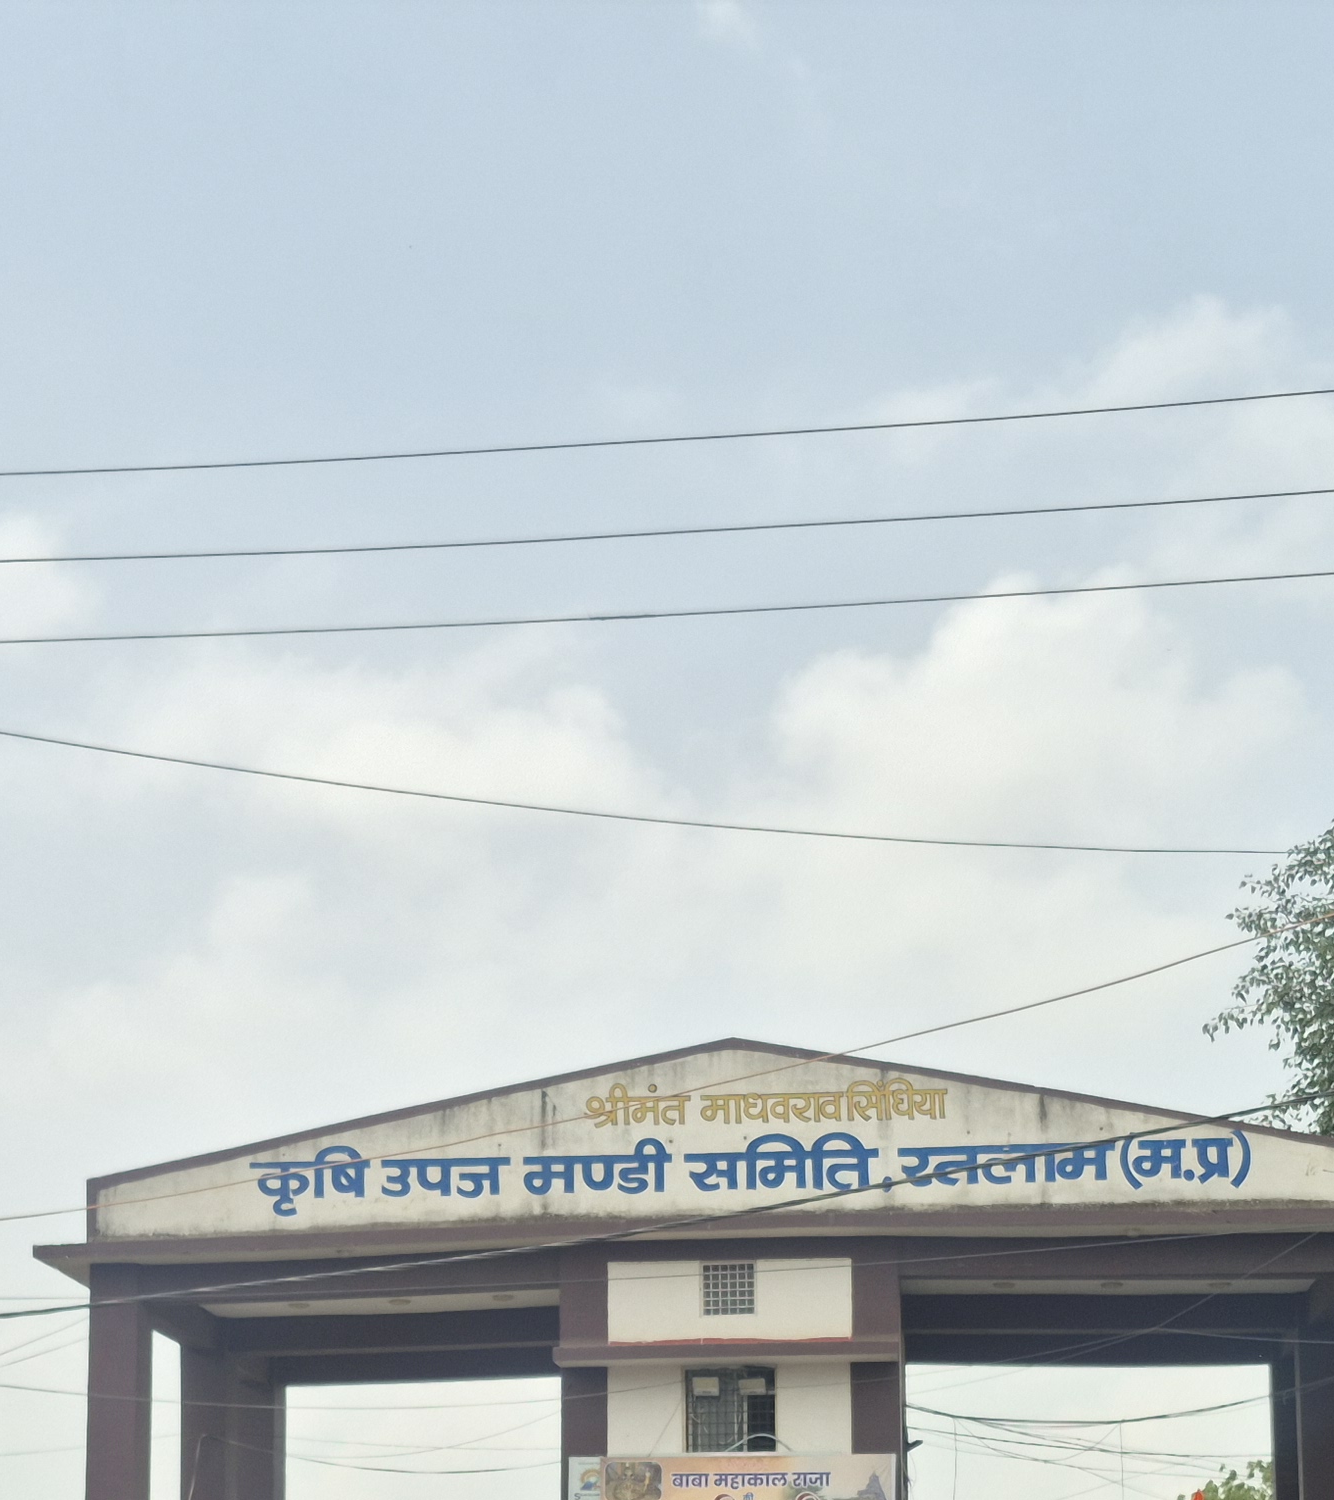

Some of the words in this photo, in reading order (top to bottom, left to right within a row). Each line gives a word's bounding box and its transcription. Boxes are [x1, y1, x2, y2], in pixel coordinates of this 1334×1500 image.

[584, 1083, 691, 1128] श्रीमंत
[700, 1091, 843, 1124] माधवराव
[845, 1078, 948, 1122] सिंधिया
[249, 1145, 371, 1217] कृषि
[381, 1156, 511, 1199] उपज
[522, 1137, 673, 1196] मण्डी
[671, 1473, 710, 1489] बाबा
[713, 1472, 789, 1490] महाकाल
[791, 1472, 832, 1488] राजा
